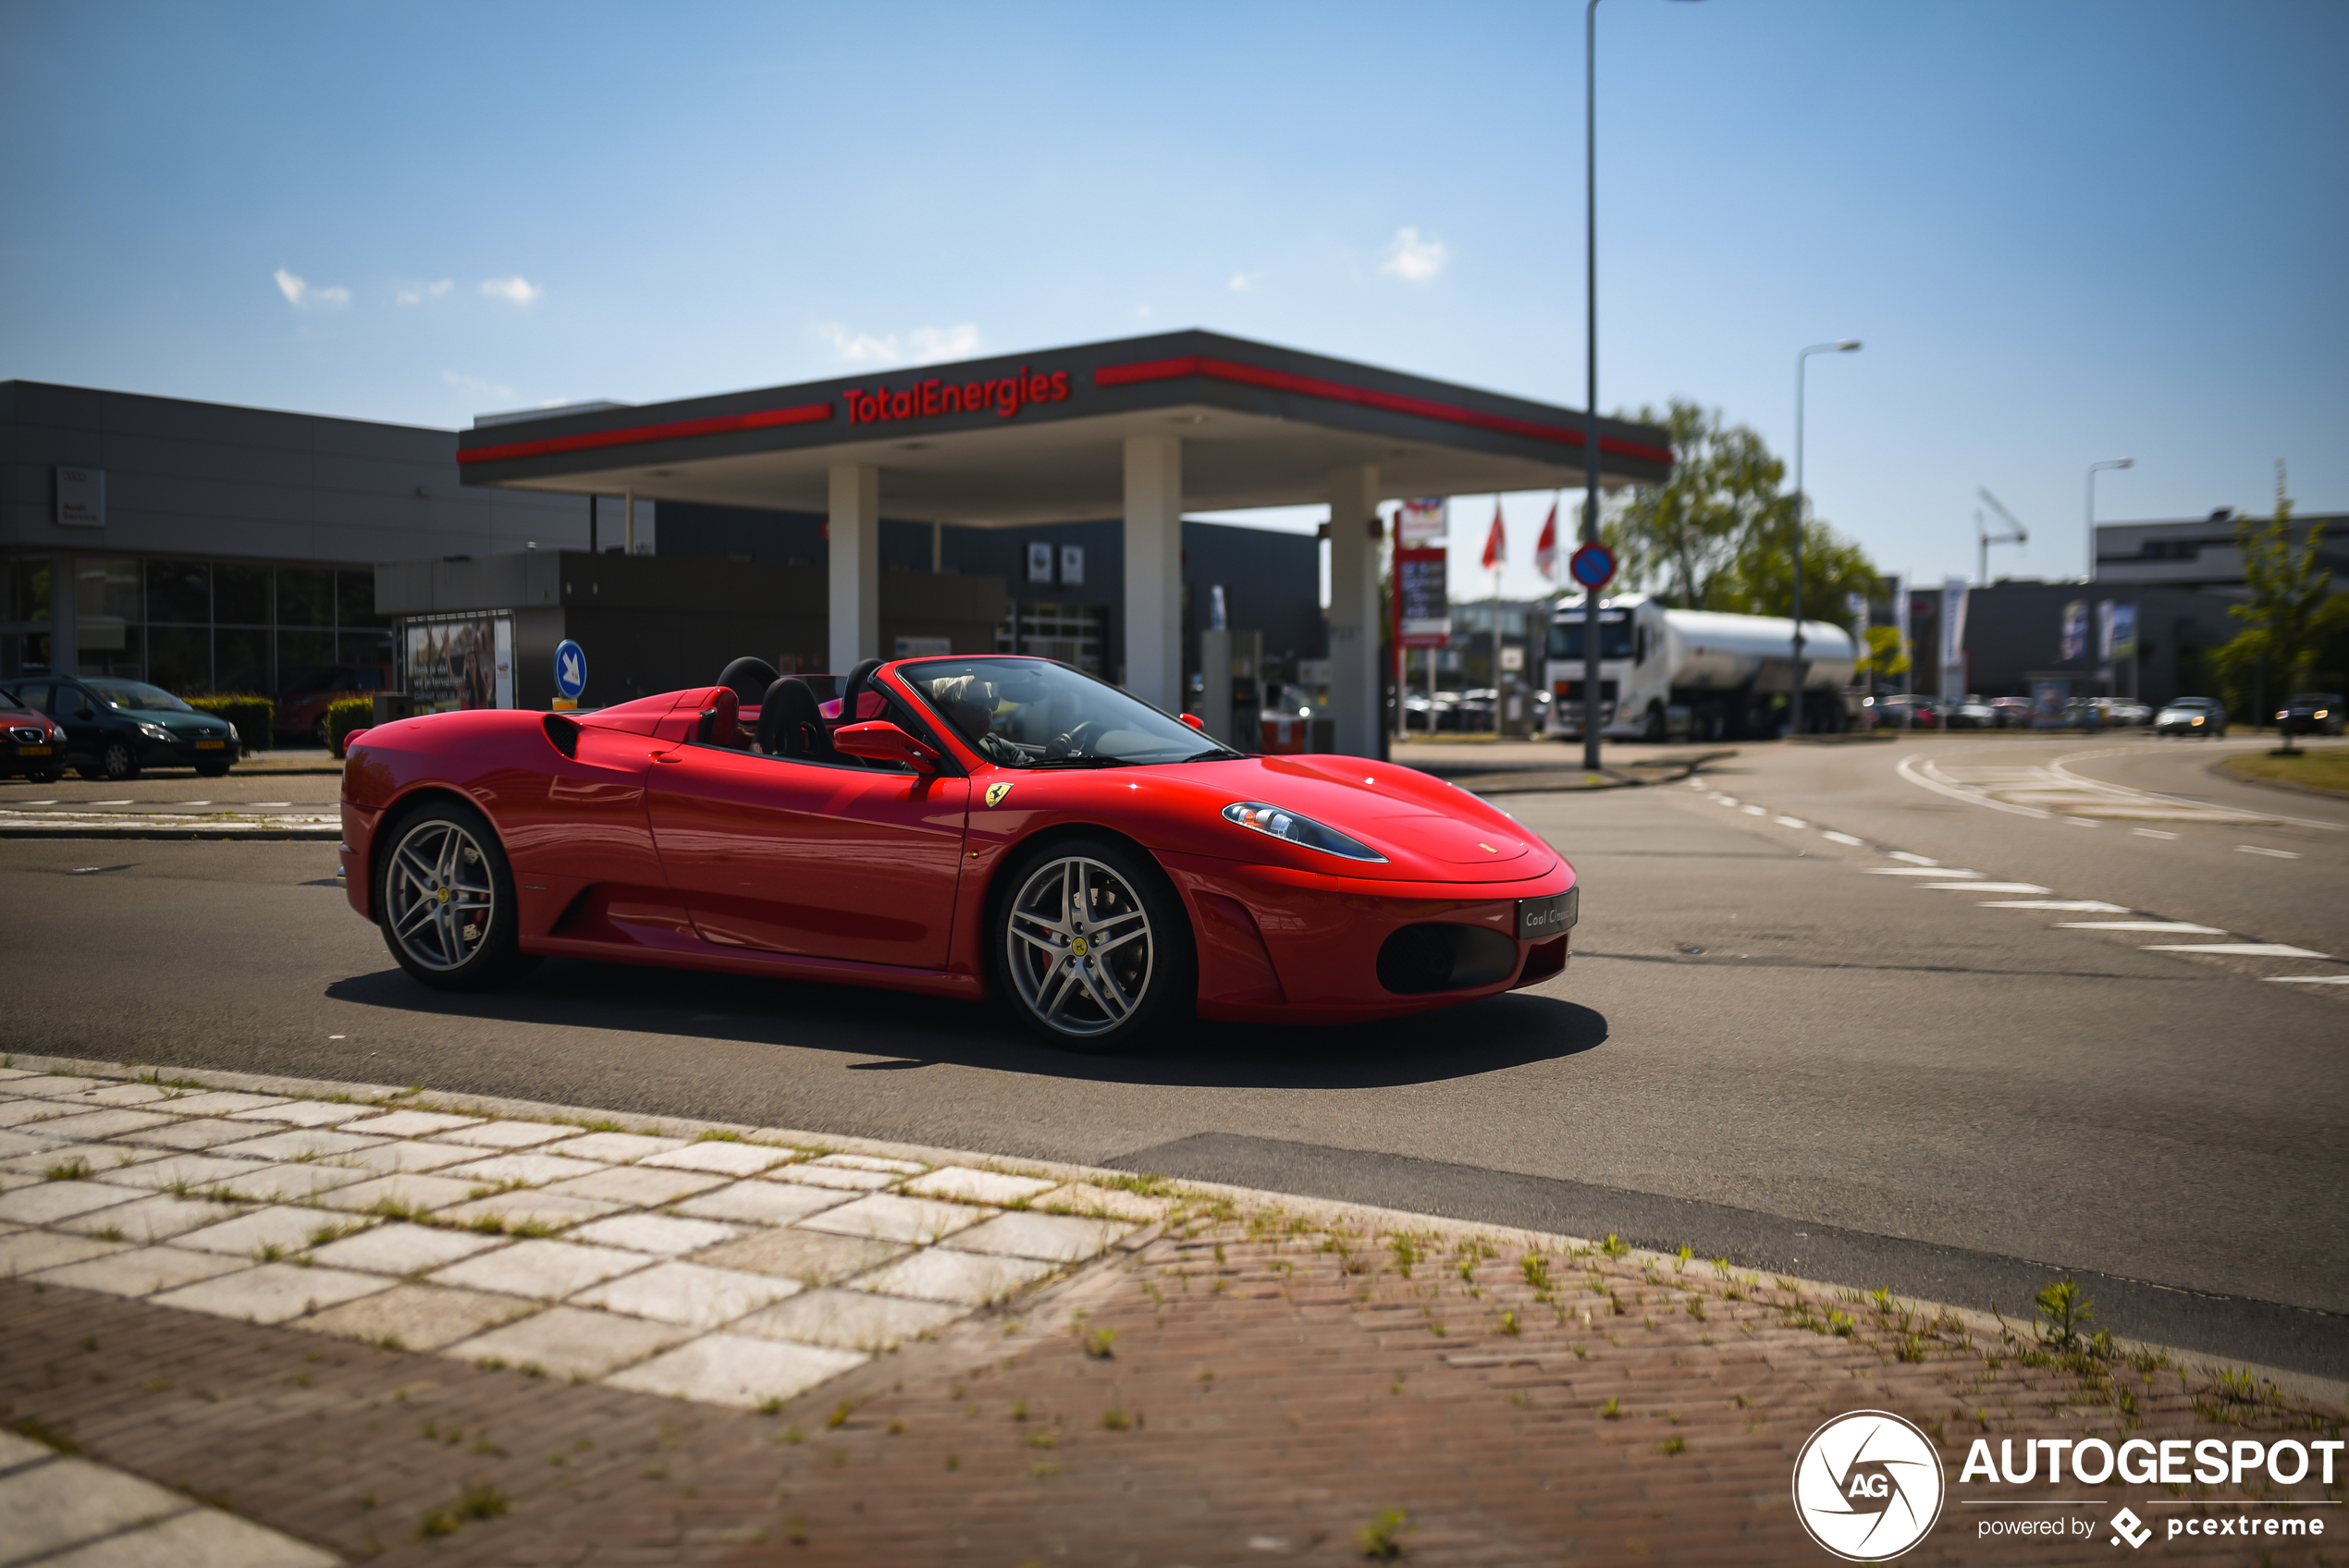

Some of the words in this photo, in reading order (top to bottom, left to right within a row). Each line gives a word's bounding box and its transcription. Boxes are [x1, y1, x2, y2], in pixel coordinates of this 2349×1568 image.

[842, 365, 1069, 424] TotalEnergies
[1526, 910, 1547, 926] Cool
[1549, 907, 1569, 924] Classic
